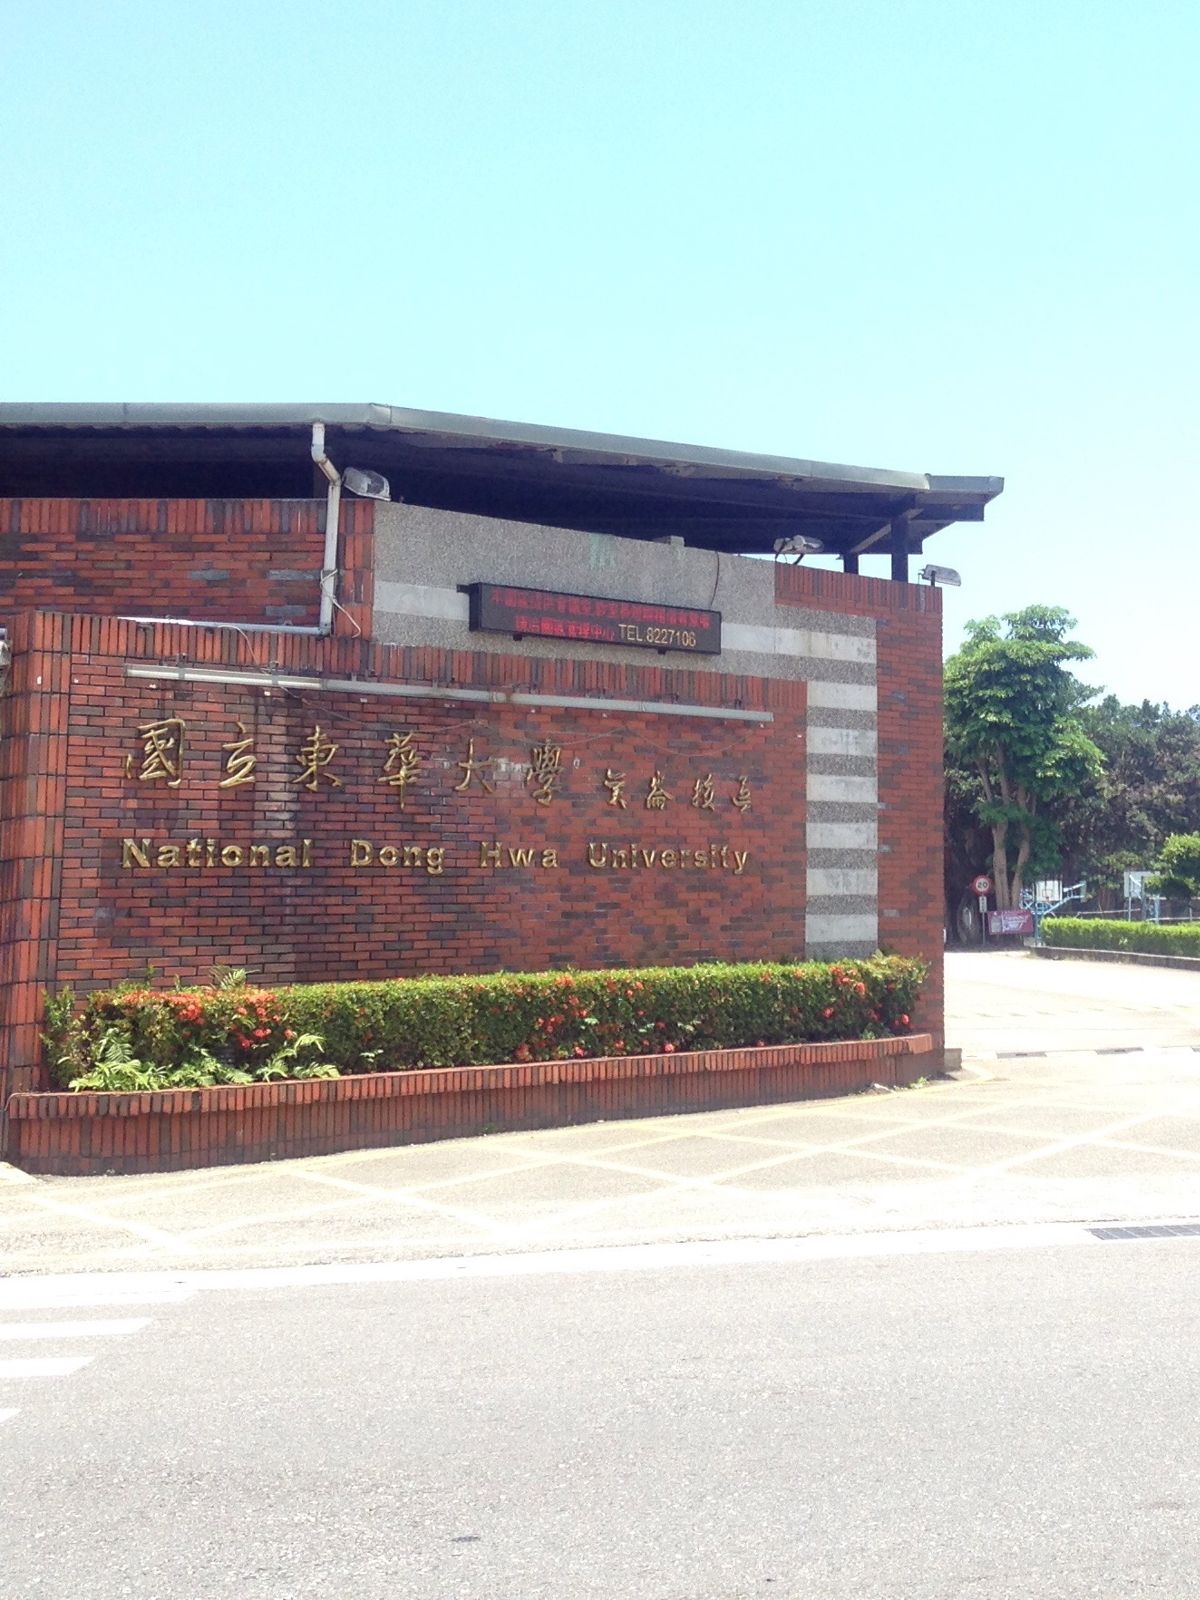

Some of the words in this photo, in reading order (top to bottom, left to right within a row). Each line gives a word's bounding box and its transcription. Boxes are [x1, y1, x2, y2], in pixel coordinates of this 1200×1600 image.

[125, 718, 564, 811] 國立東華大學
[121, 837, 313, 868] National
[350, 839, 445, 875] Dong
[480, 841, 559, 868] Hwa
[588, 842, 750, 875] University
